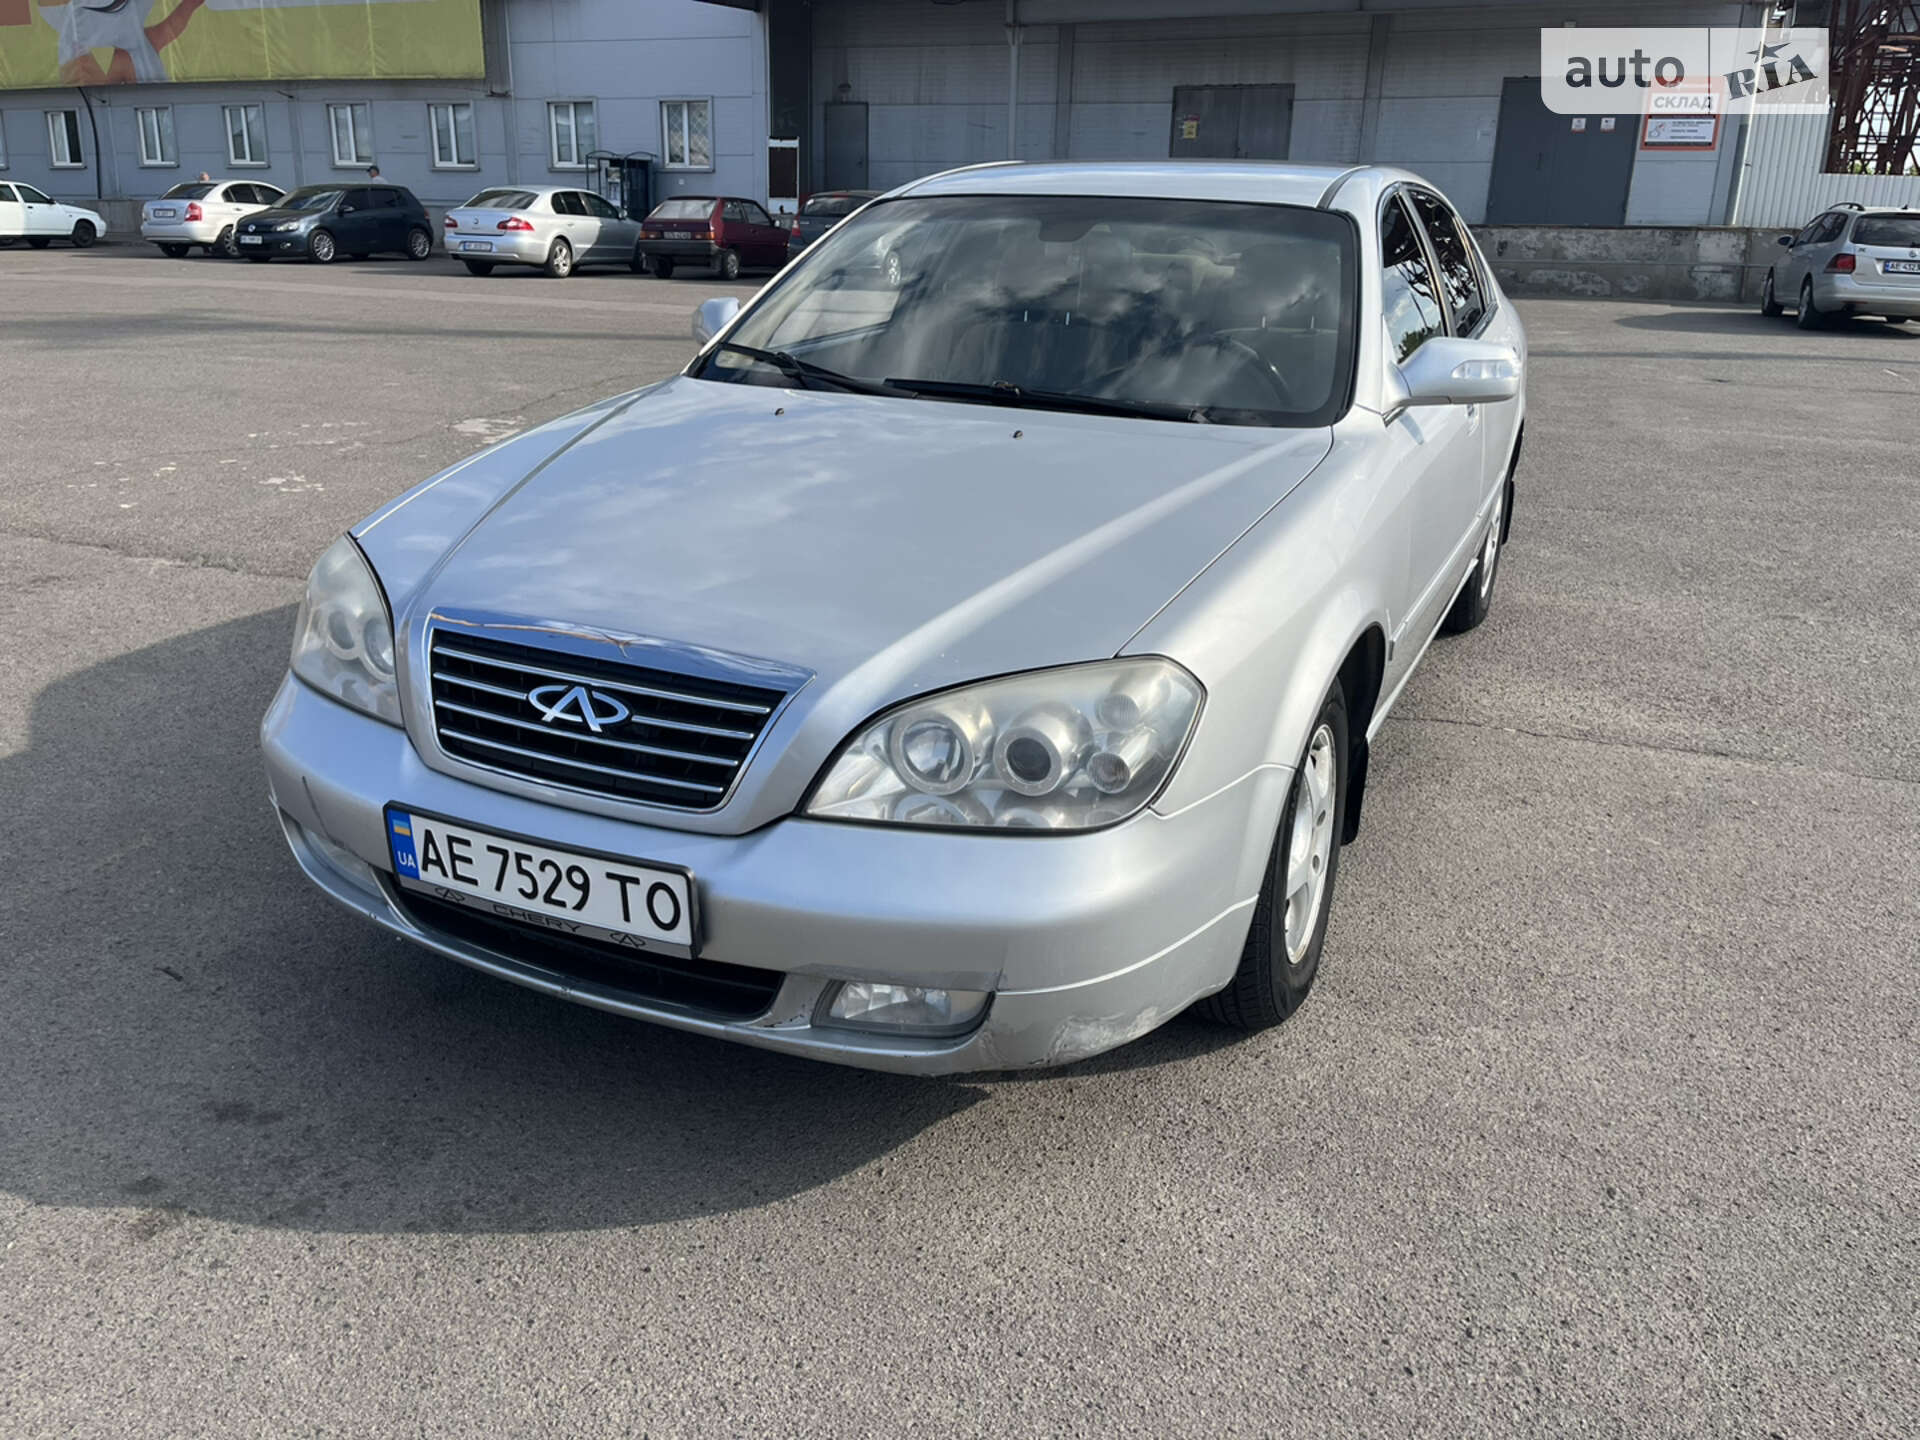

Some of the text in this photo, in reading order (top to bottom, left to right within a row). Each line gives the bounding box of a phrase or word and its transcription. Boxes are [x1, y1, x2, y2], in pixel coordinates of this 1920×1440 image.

[1654, 96, 1713, 110] СКЛАД
[397, 850, 417, 870] UA
[421, 829, 681, 932] AE 7529 TO
[491, 904, 583, 932] CHERY
